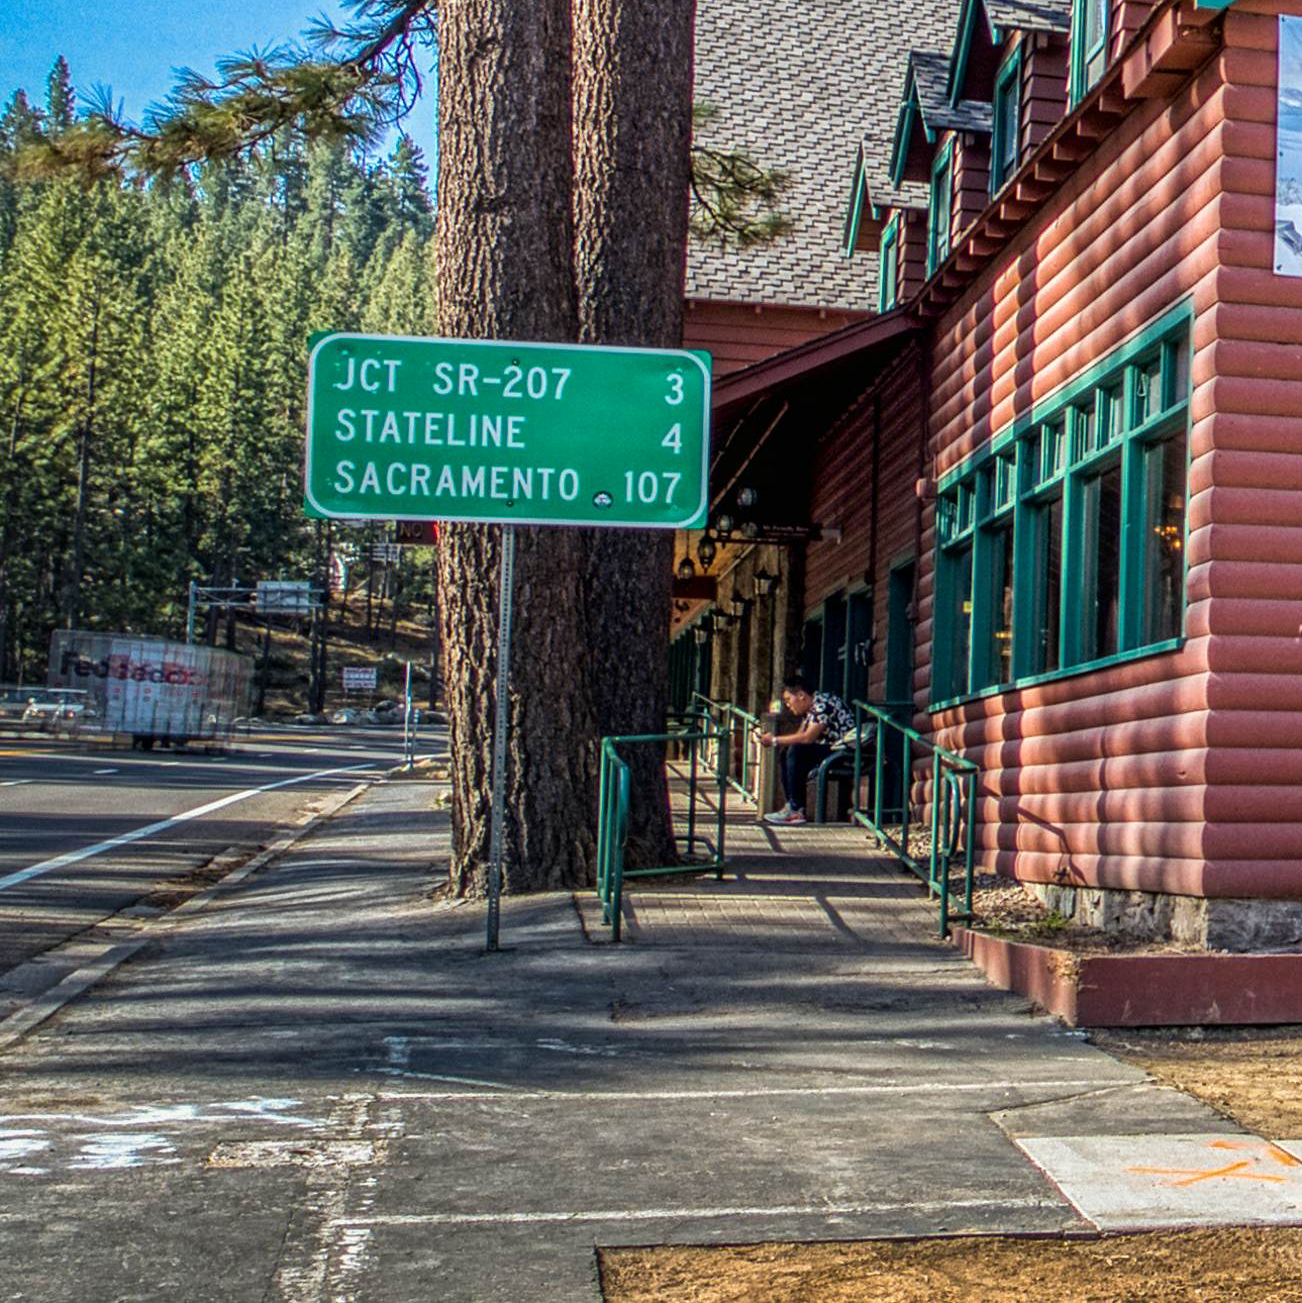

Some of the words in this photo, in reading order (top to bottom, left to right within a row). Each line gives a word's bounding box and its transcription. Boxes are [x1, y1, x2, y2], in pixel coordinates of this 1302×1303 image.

[336, 358, 402, 393] JCT
[432, 362, 572, 400] SR-207
[664, 373, 684, 405] 3
[335, 408, 526, 449] STATELINE
[661, 423, 682, 455] 4
[334, 459, 579, 501] SACRAMENTO
[624, 470, 682, 504] 107
[400, 521, 424, 538] NO
